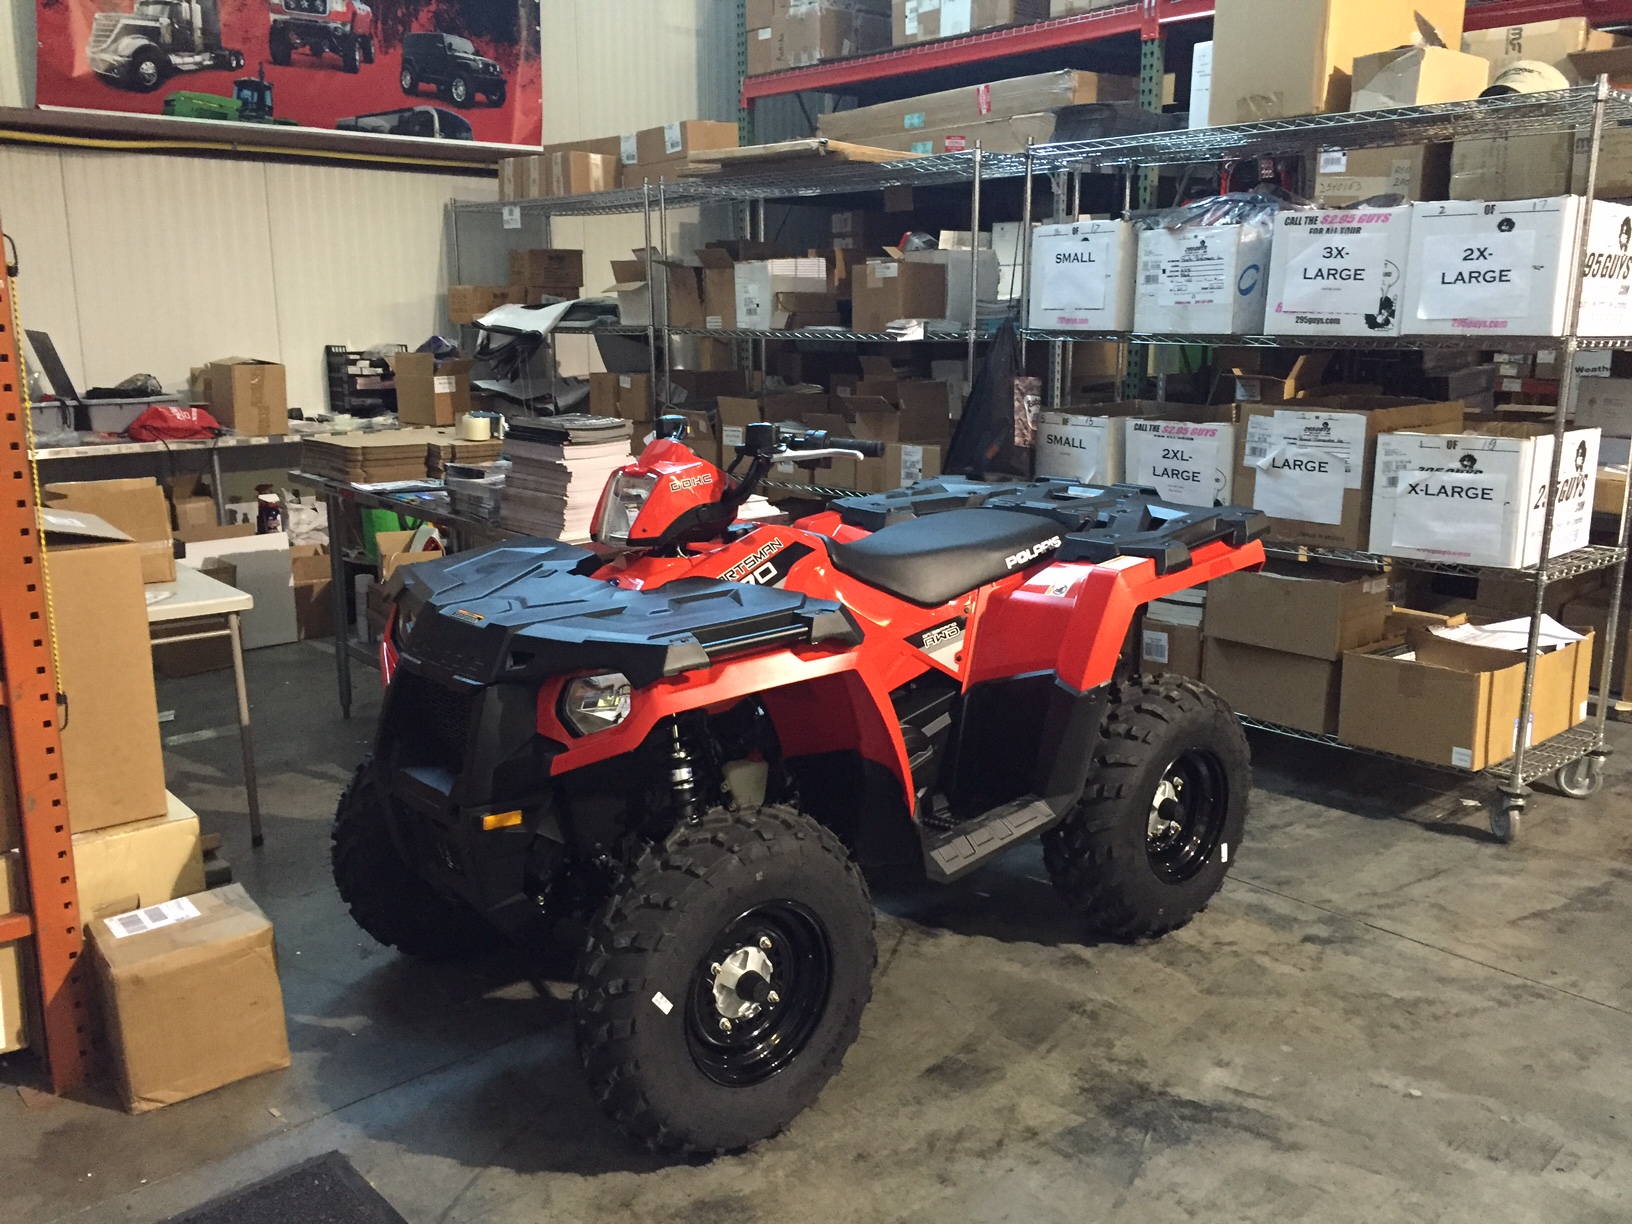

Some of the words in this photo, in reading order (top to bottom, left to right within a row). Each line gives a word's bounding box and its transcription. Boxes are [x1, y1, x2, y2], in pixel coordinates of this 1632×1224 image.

[1484, 204, 1497, 215] OF
[1284, 216, 1302, 226] CALL
[1304, 215, 1319, 226] THE
[1320, 214, 1357, 225] $2.95
[1357, 213, 1392, 224] GUYS
[1309, 227, 1325, 235] FOR
[1340, 226, 1362, 235] YOUR
[1055, 252, 1095, 264] SMALL
[1322, 246, 1350, 259] 3X-
[1462, 247, 1493, 261] 2X-
[1583, 252, 1632, 280] 95GUYS
[1303, 268, 1365, 281] LARGE
[1441, 269, 1512, 285] LARGE
[1295, 316, 1341, 325] 295guys.com
[1574, 365, 1610, 373] Weath
[1133, 422, 1148, 431] CALL
[1149, 423, 1160, 433] THE
[1161, 425, 1189, 435] $2.95
[1190, 427, 1218, 437] GUYS
[1046, 434, 1087, 450] SMALL
[1446, 440, 1459, 450] OF
[1161, 448, 1193, 462] 2XL-
[1272, 457, 1329, 473] LARGE
[1152, 465, 1201, 483] LARGE
[669, 474, 713, 492] DOHC
[1407, 483, 1494, 501] X-LARGE
[1005, 535, 1062, 569] POLARIS
[717, 537, 783, 582] RTSMAN
[923, 626, 961, 649] AWD
